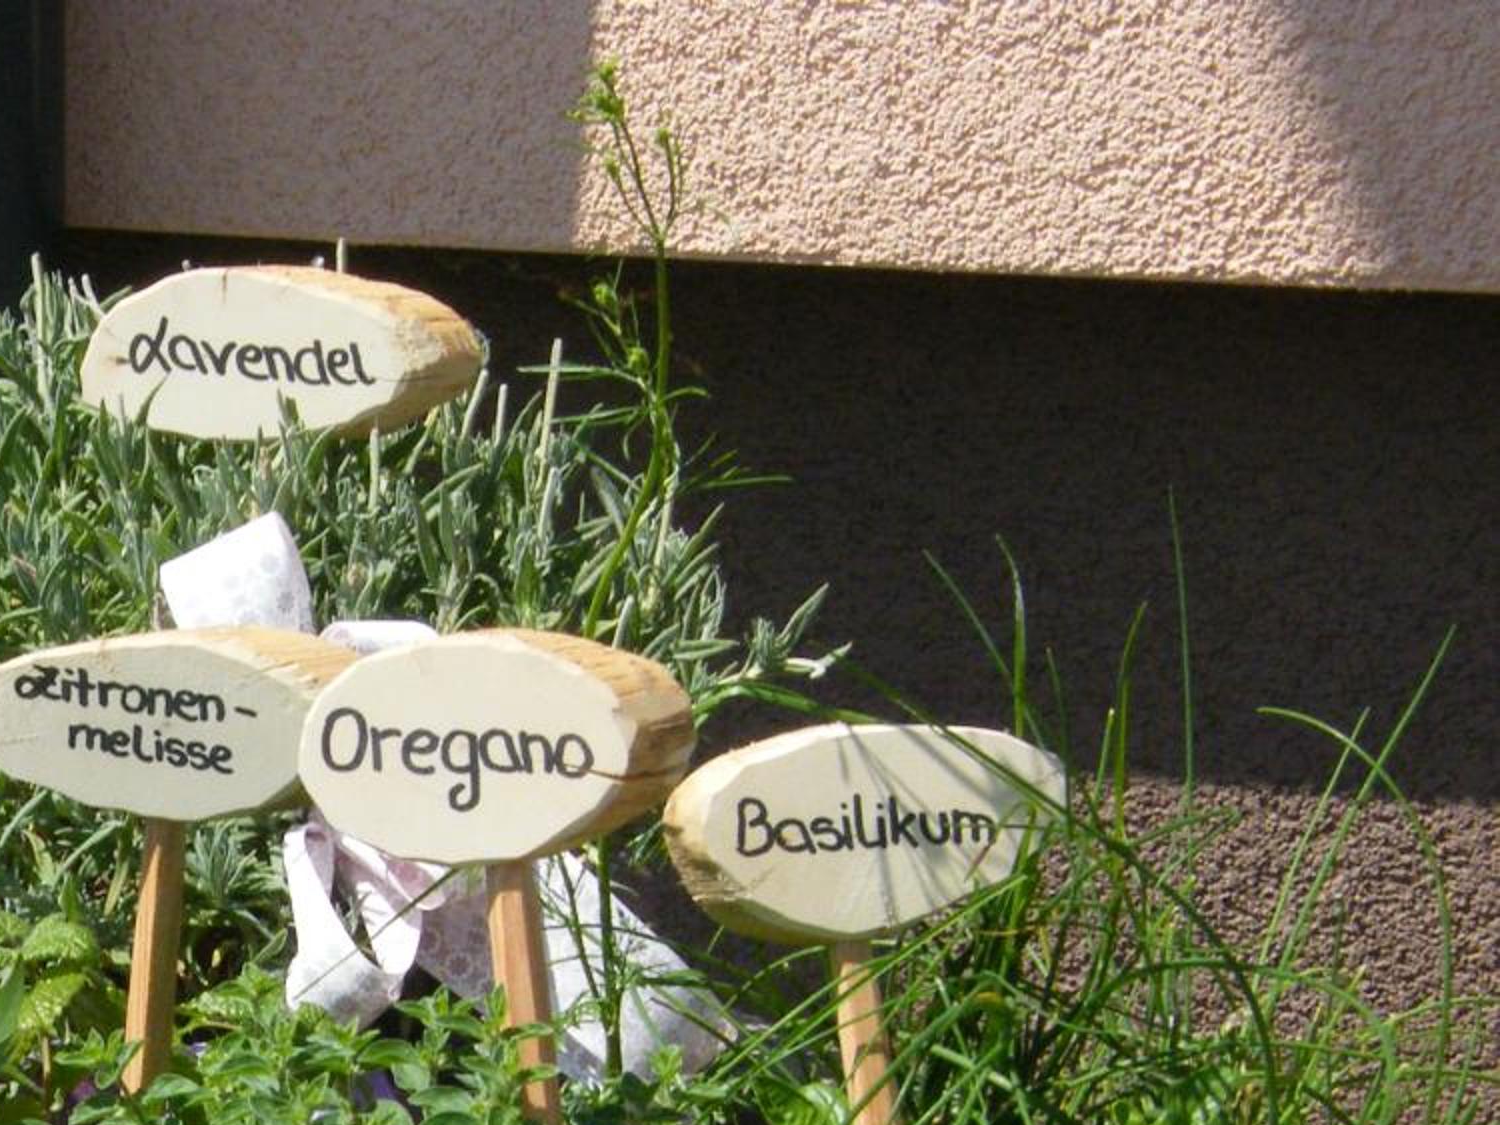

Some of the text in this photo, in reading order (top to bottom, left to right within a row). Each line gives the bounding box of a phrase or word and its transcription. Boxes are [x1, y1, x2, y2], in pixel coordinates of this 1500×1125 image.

[128, 316, 375, 385] Lavendel
[68, 723, 234, 775] melisse
[320, 706, 595, 812] Oregano
[735, 793, 997, 857] Basilikum
